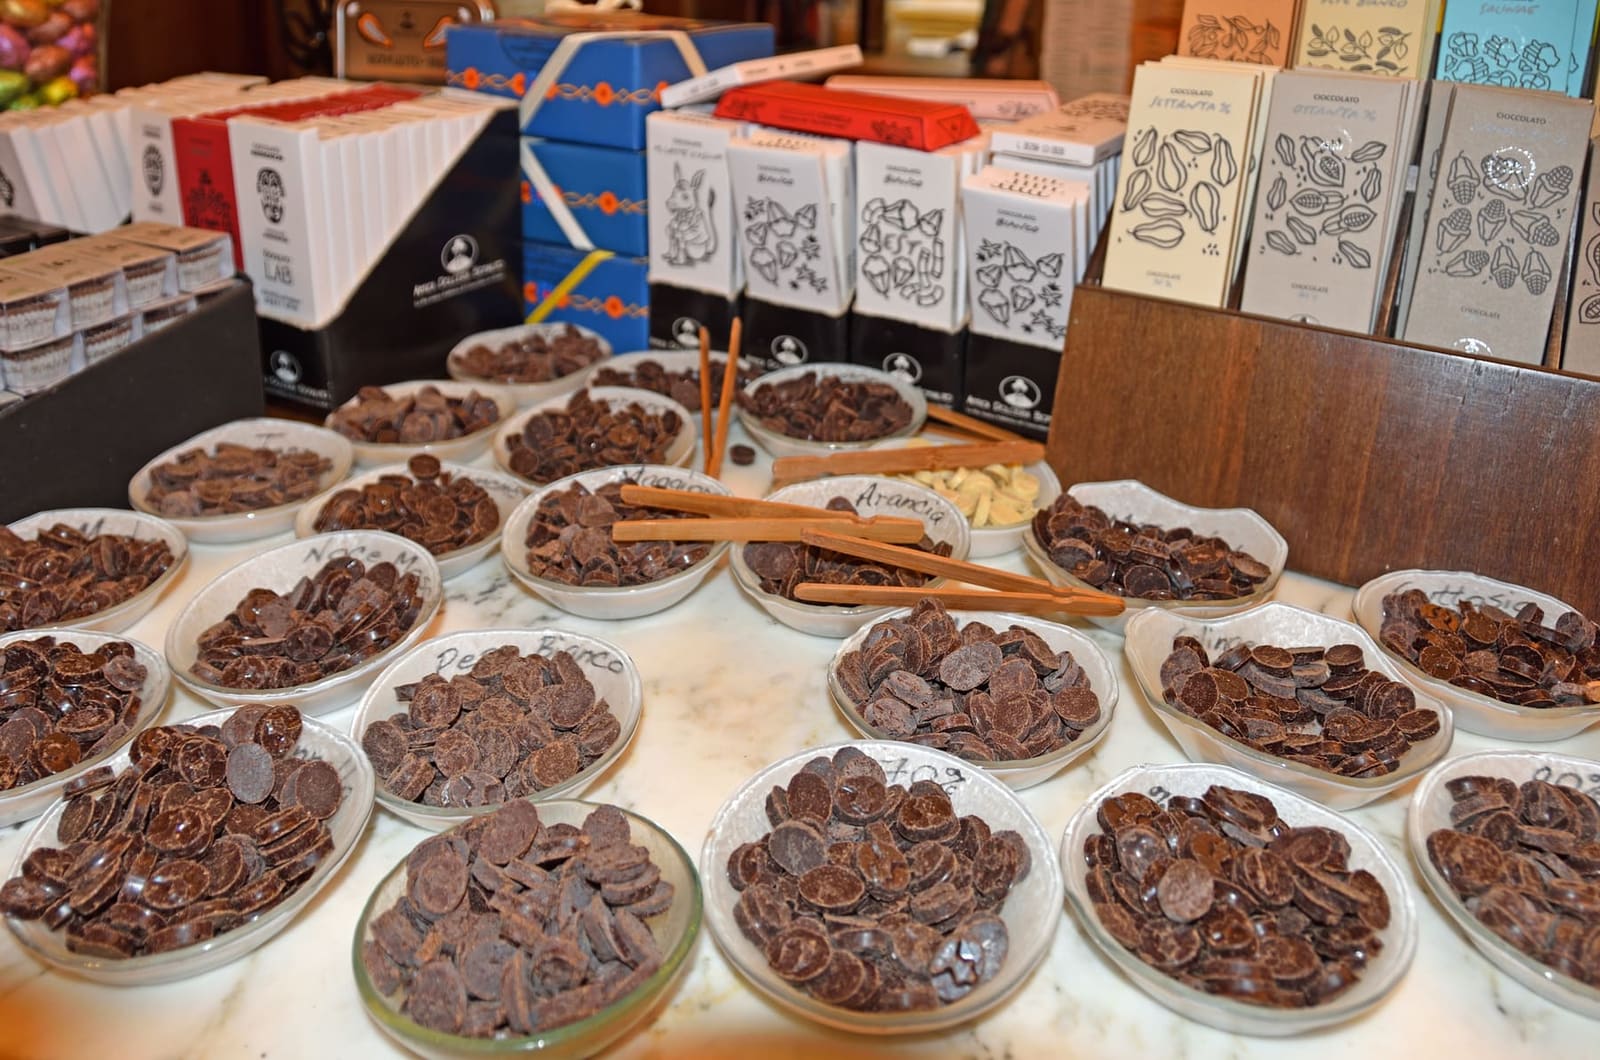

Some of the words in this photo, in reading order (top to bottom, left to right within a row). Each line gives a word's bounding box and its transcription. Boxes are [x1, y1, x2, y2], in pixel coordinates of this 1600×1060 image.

[1313, 93, 1360, 104] CIOCCOLATO
[1496, 111, 1547, 125] CIOCCOLATO
[855, 482, 945, 526] Arancia
